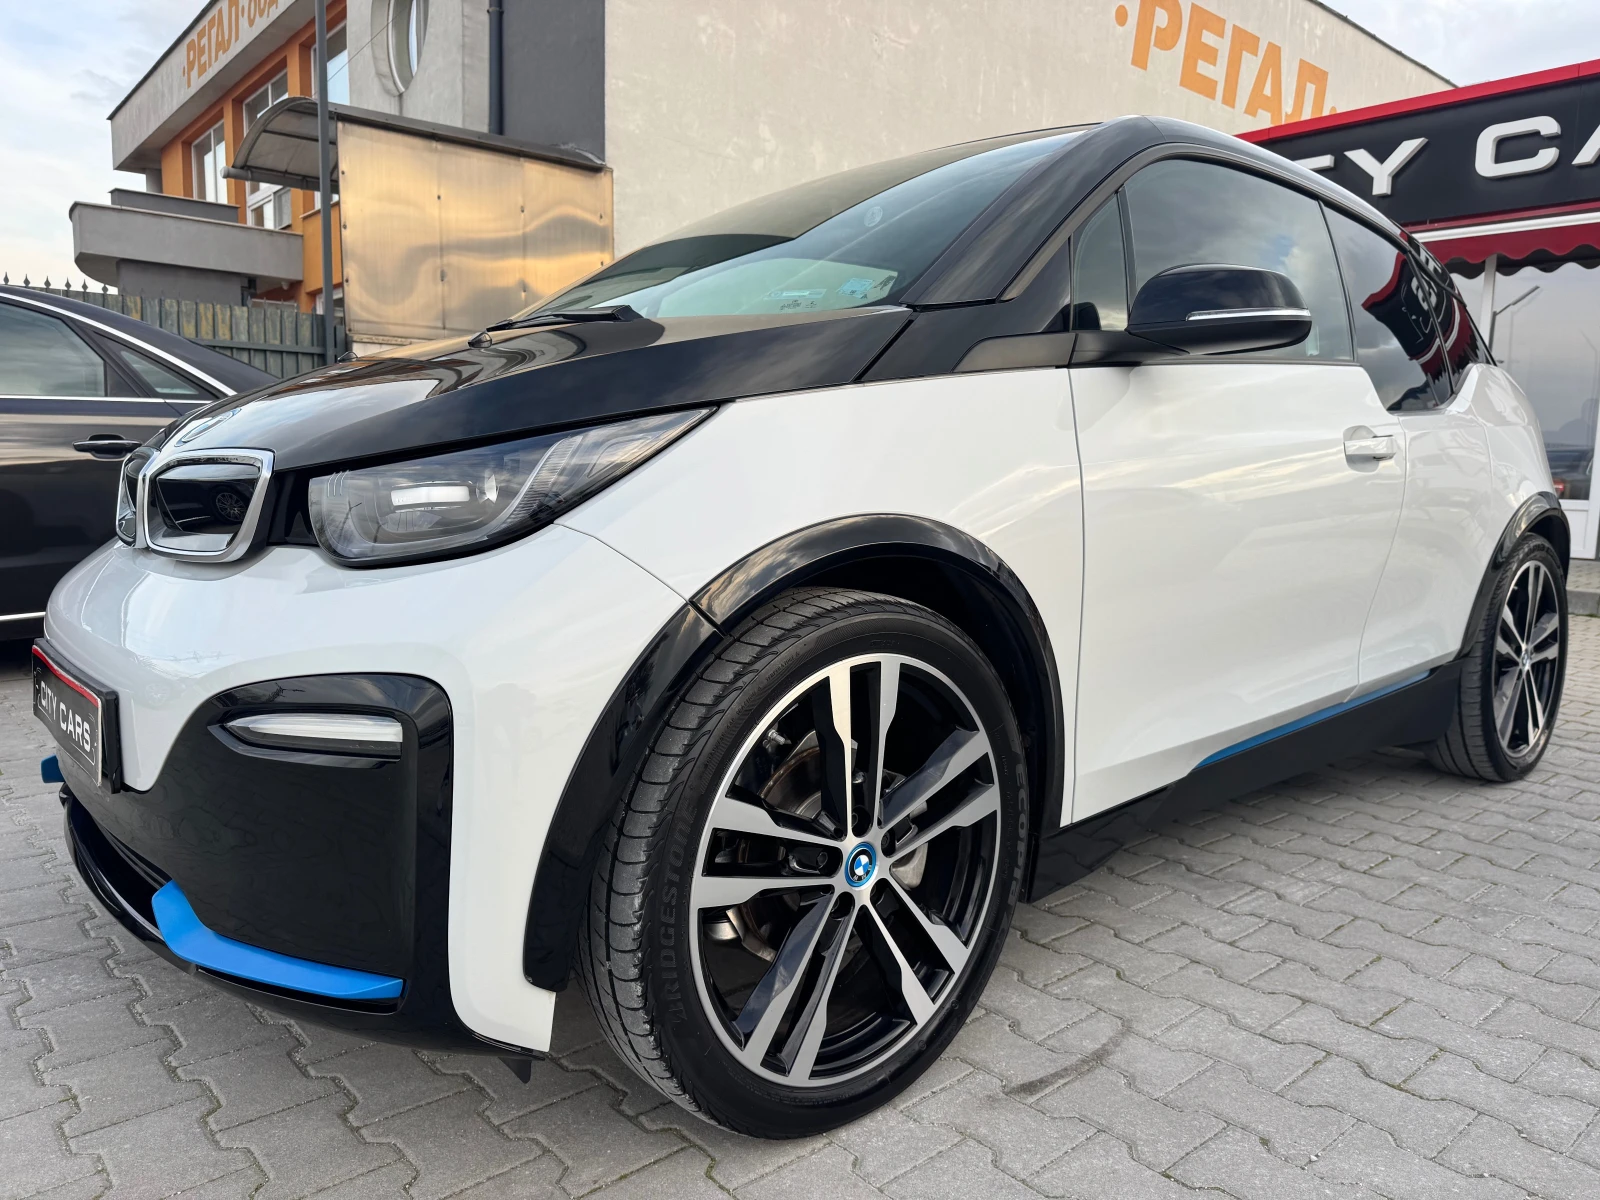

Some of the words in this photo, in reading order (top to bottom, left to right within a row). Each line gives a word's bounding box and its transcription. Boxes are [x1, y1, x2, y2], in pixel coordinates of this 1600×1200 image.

[41, 680, 57, 721] CITY
[60, 702, 91, 752] CARS
[661, 800, 698, 1024] BRIDGESTONE
